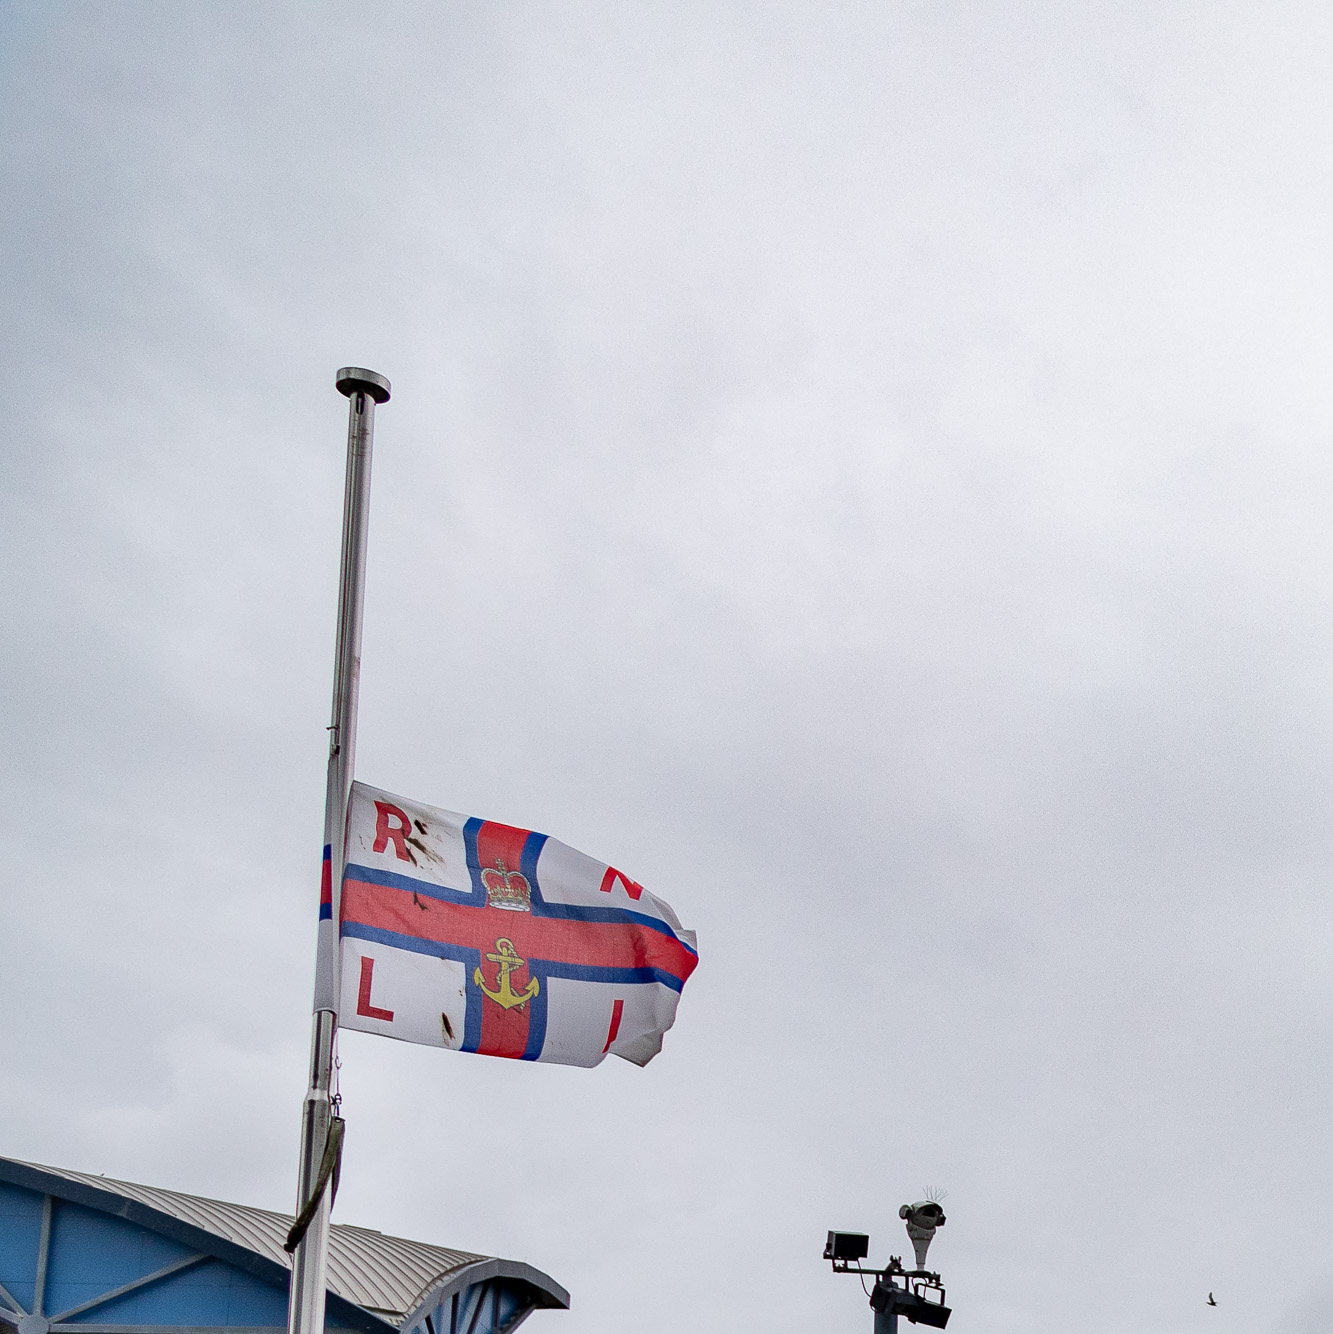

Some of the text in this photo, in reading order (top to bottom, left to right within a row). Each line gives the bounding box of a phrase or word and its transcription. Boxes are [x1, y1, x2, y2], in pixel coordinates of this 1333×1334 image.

[373, 801, 643, 900] R N
[356, 956, 624, 1053] L I
